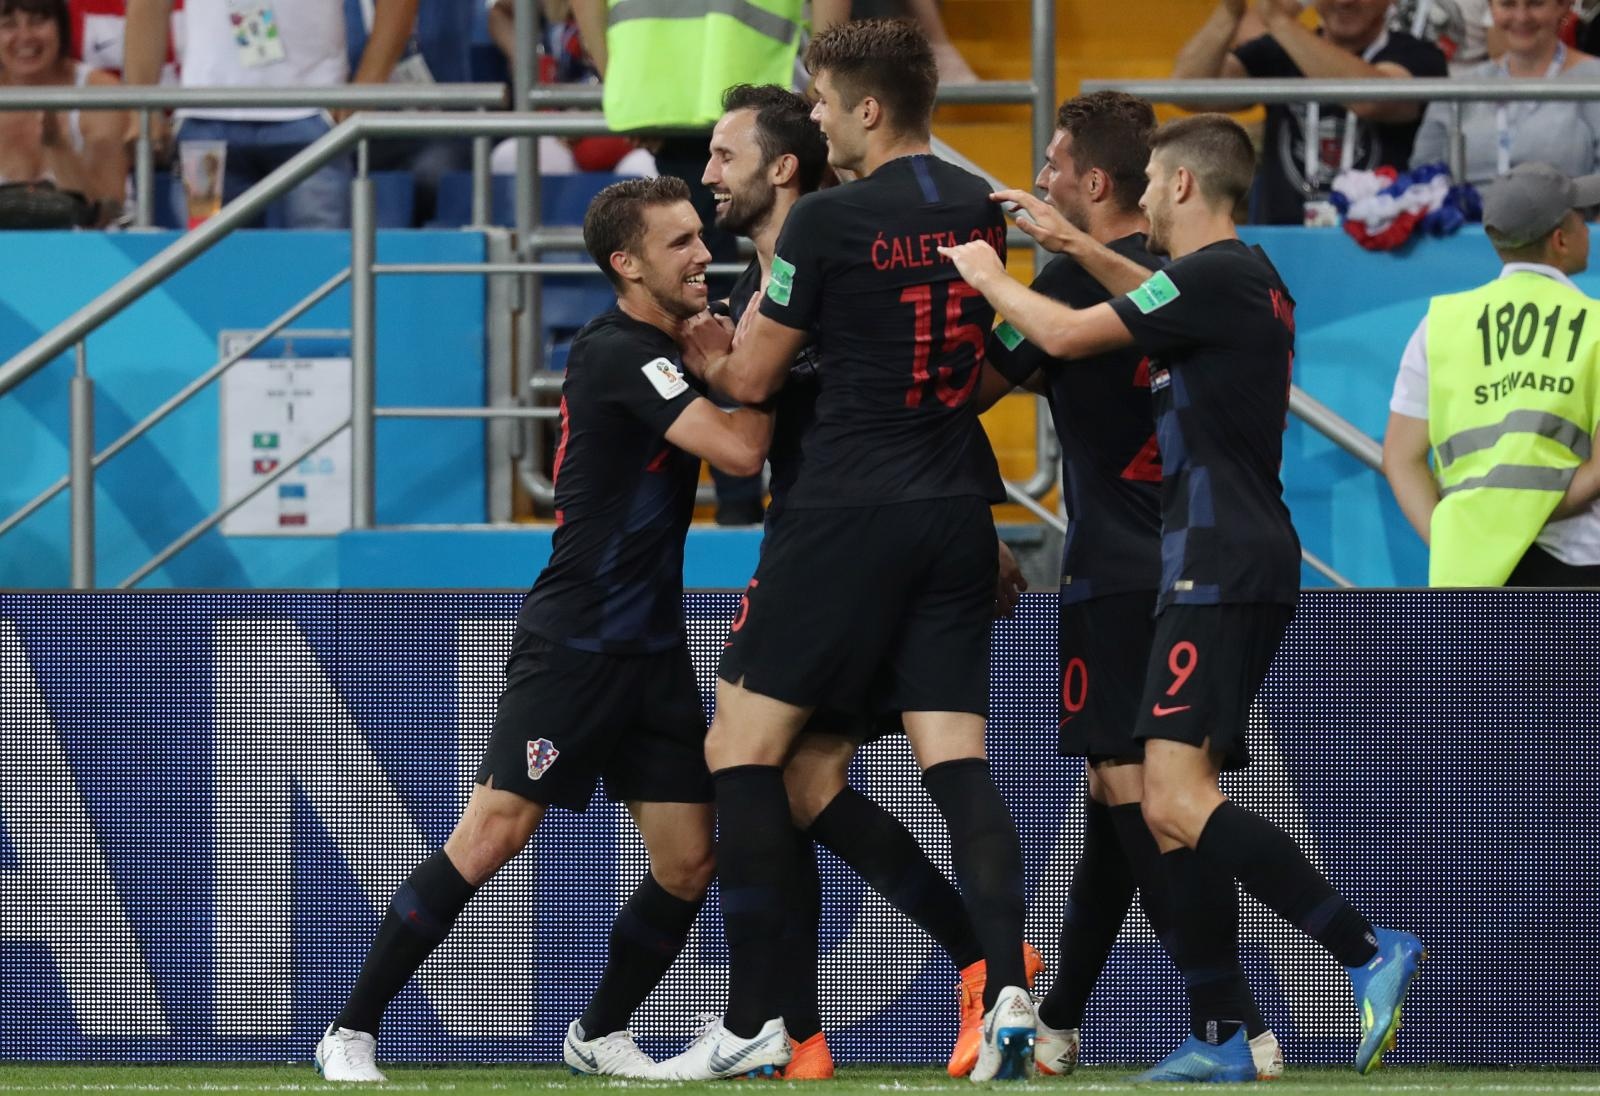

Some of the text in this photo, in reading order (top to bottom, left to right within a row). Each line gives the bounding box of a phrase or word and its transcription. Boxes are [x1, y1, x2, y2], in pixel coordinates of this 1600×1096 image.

[899, 280, 985, 408] 15
[1476, 301, 1587, 366] 18011
[1474, 371, 1575, 405] STEWARD
[1166, 640, 1198, 696] 9
